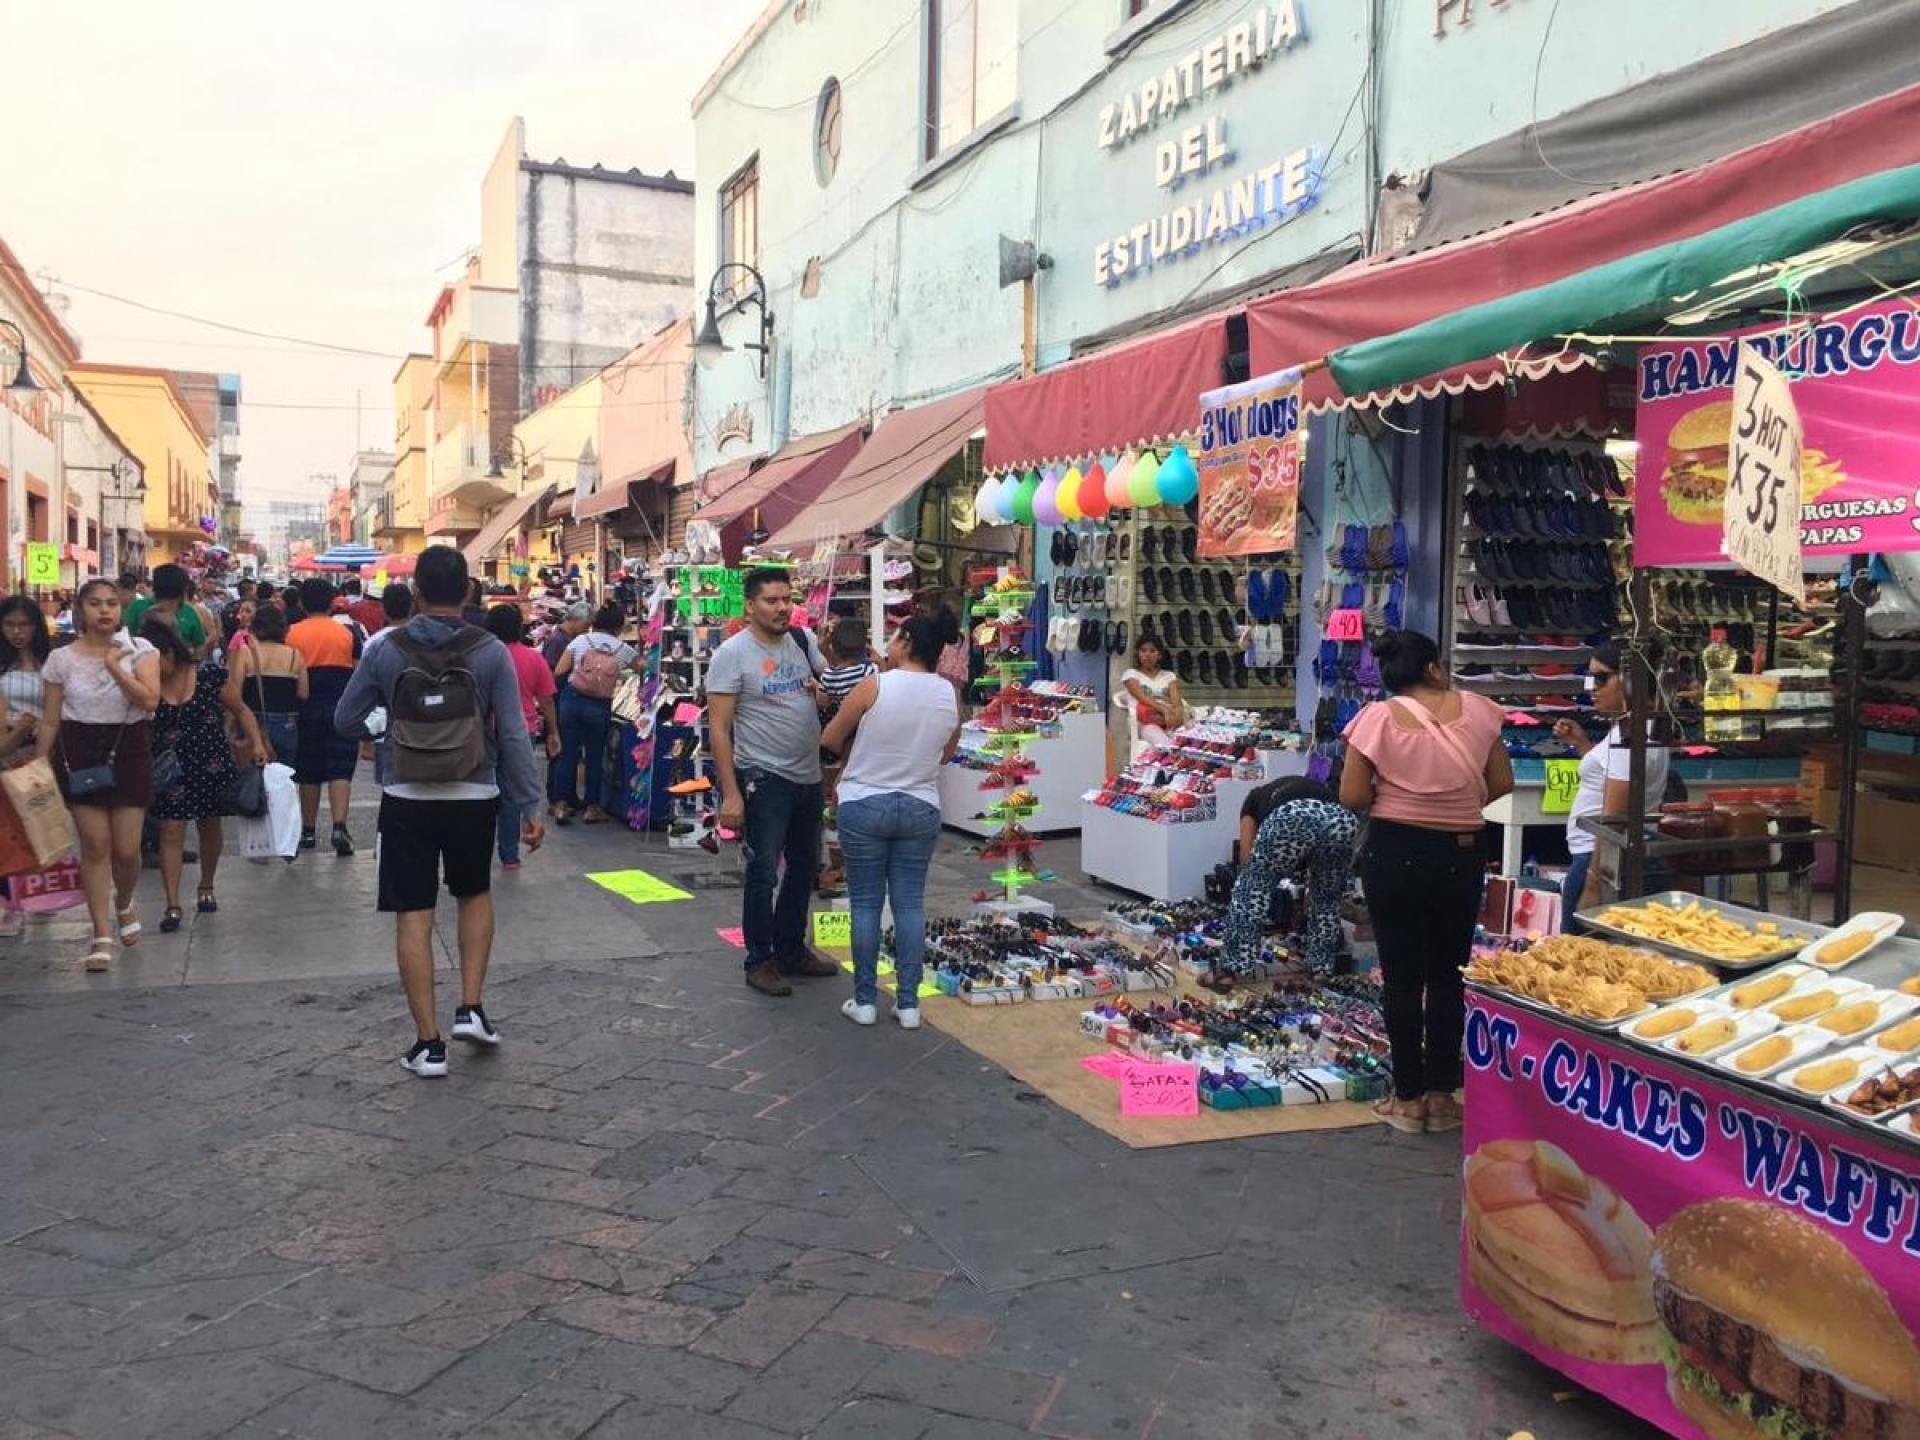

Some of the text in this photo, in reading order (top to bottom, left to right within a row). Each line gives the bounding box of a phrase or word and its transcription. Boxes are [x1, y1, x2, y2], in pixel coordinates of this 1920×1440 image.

[1098, 0, 1300, 149] ZAPATERIA
[1155, 116, 1228, 188] DEL
[1094, 149, 1313, 285] ESTUDIANTE
[1201, 393, 1299, 452] 3 Hot dogs
[1756, 403, 1788, 457] HOT
[1247, 443, 1298, 491] $35
[1746, 461, 1785, 534] 35
